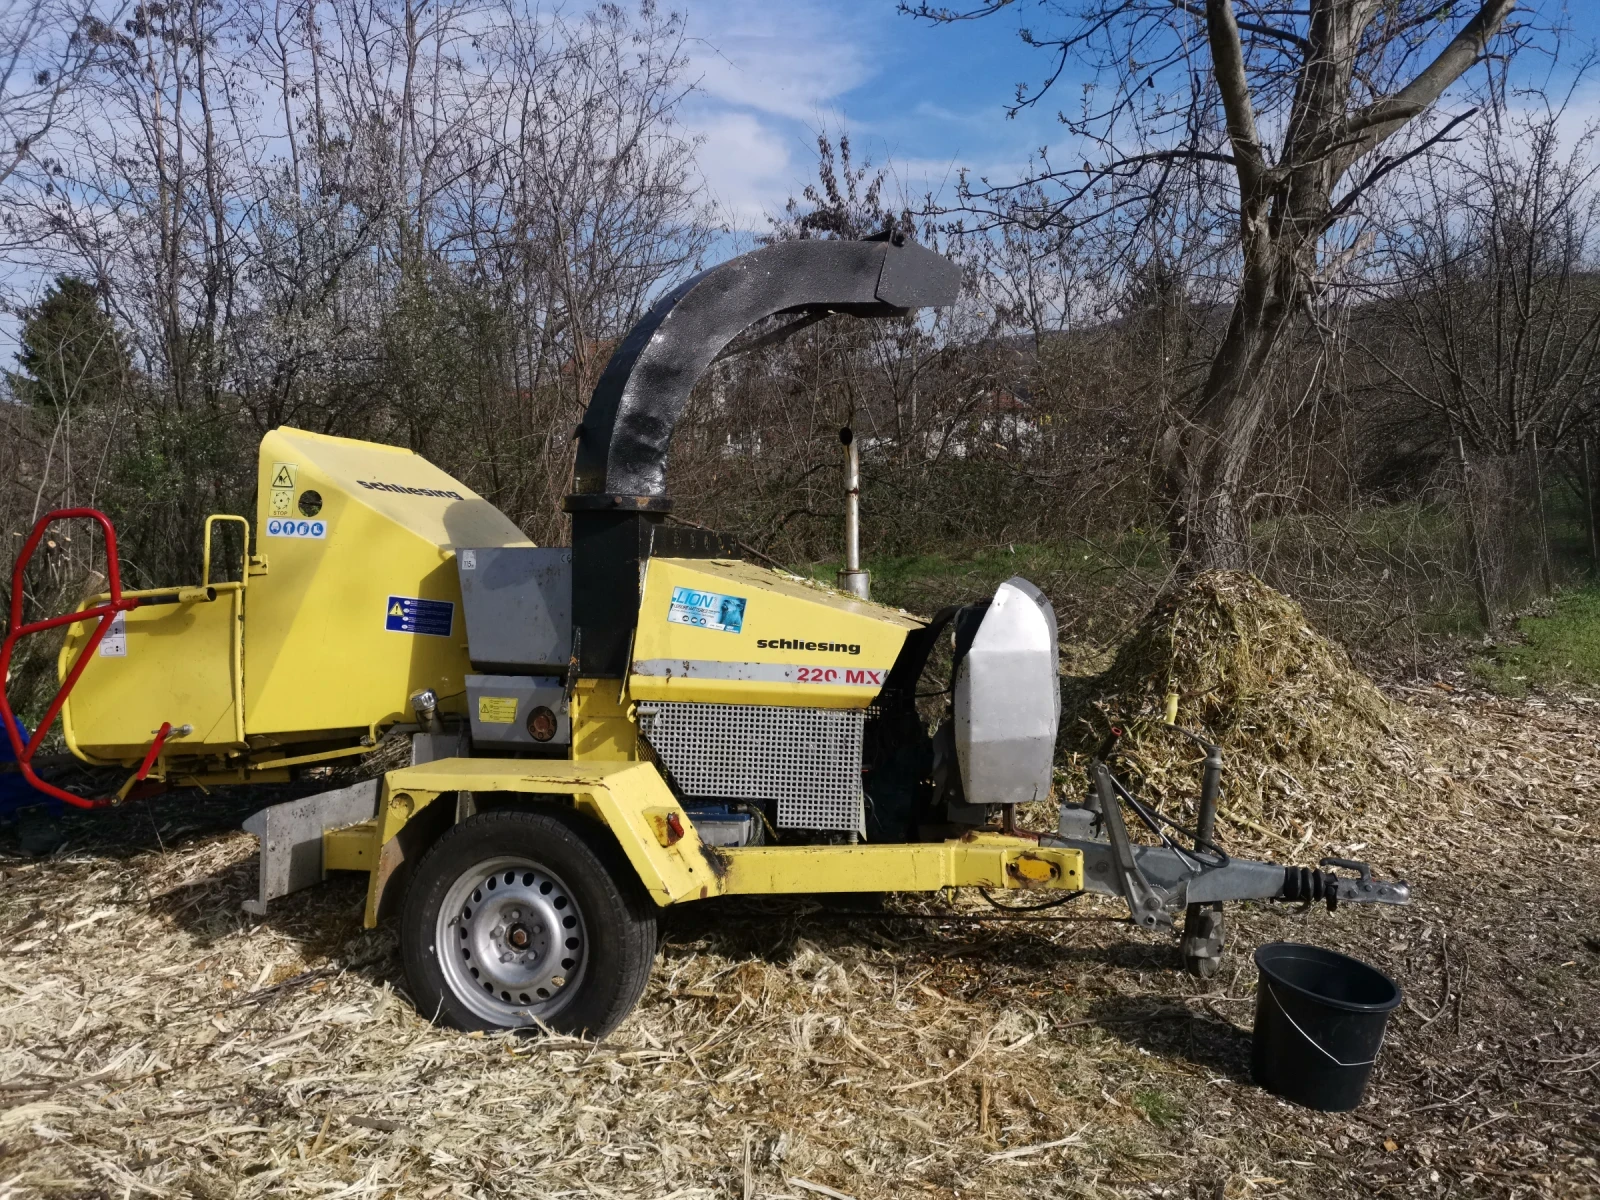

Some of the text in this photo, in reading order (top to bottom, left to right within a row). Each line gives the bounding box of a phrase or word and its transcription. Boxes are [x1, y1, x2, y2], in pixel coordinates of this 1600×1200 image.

[356, 480, 464, 501] schliesing
[675, 590, 713, 608] LION
[757, 639, 861, 655] schliesing
[797, 667, 881, 685] 220 MX
